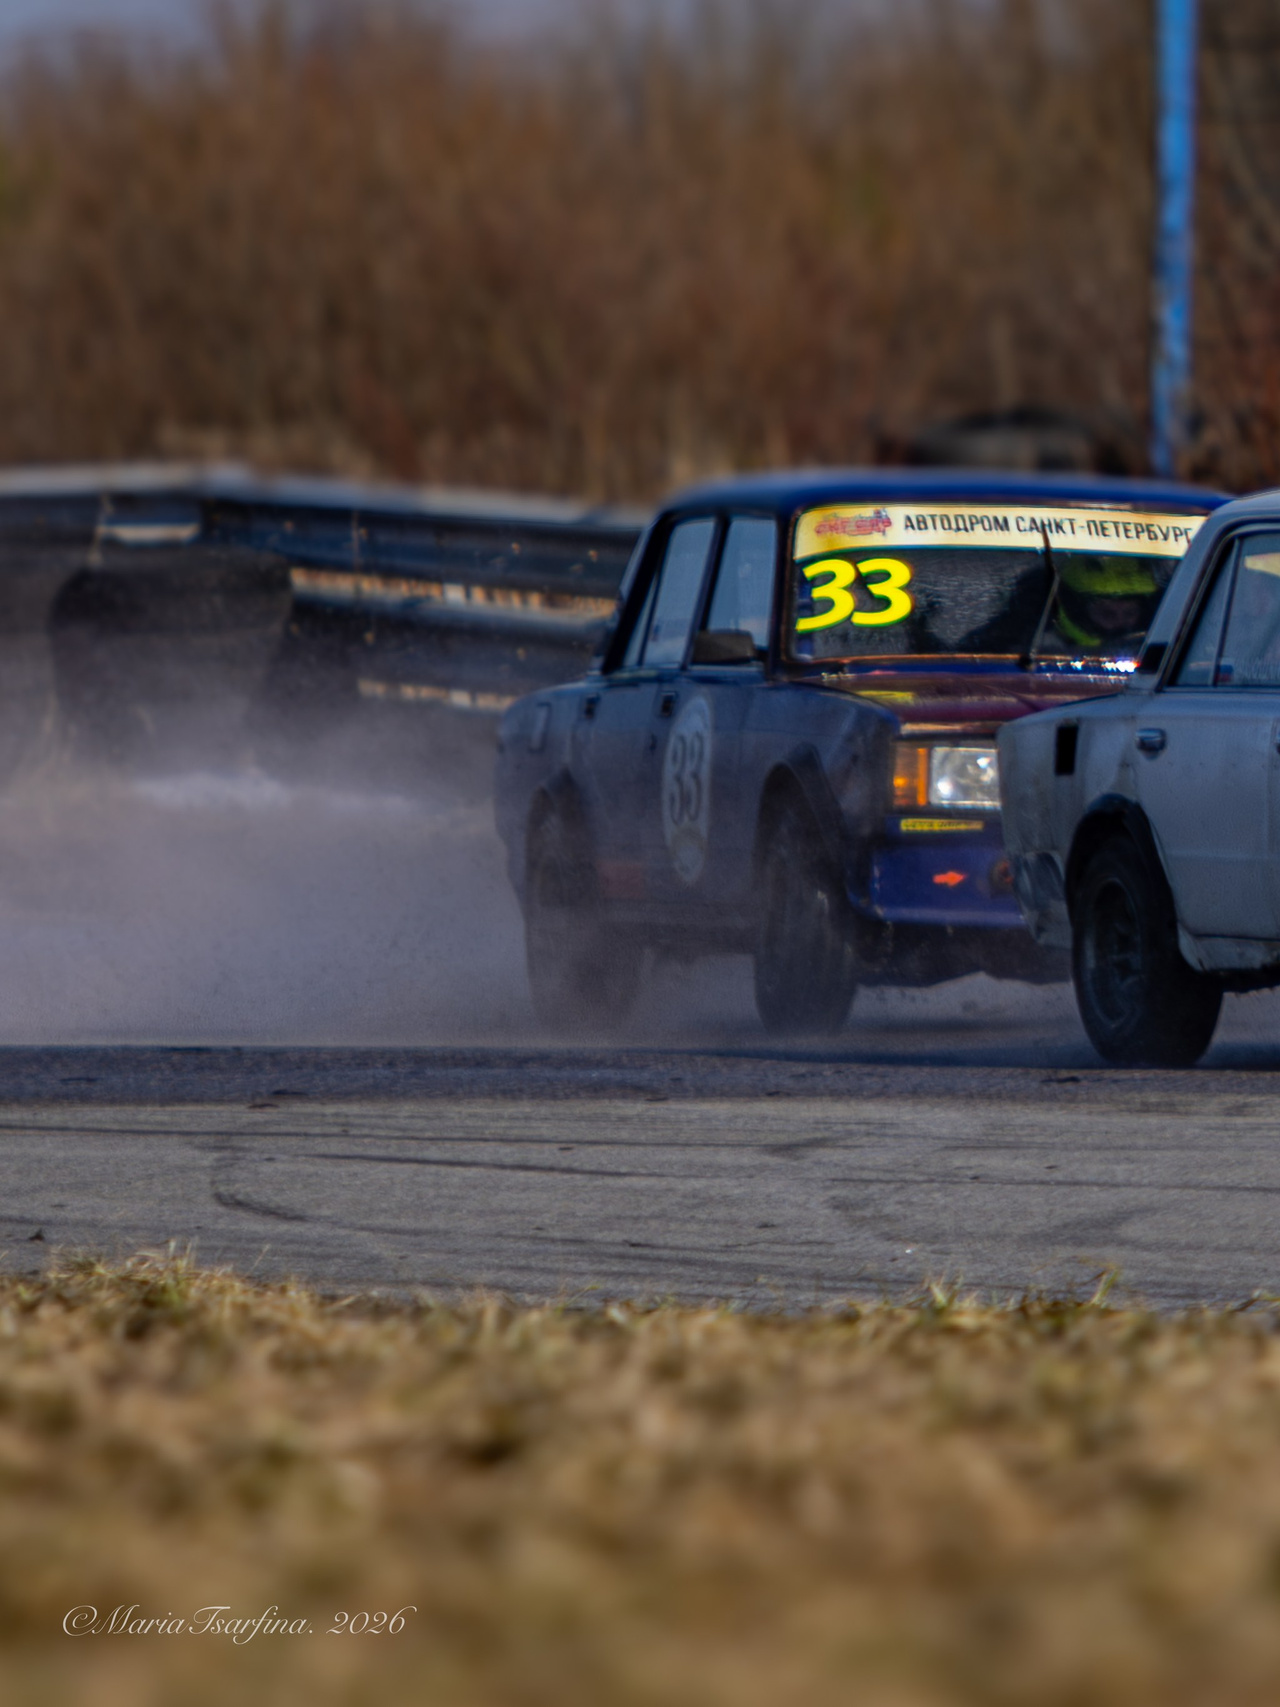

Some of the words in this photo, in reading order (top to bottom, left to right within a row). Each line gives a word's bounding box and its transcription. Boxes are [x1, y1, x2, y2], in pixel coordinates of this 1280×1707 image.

[904, 514, 1010, 533] АВТОДРОМ
[1016, 516, 1194, 546] САНКТ-ПЕТЕРБУРГ
[795, 558, 912, 633] 33
[670, 731, 704, 826] 33
